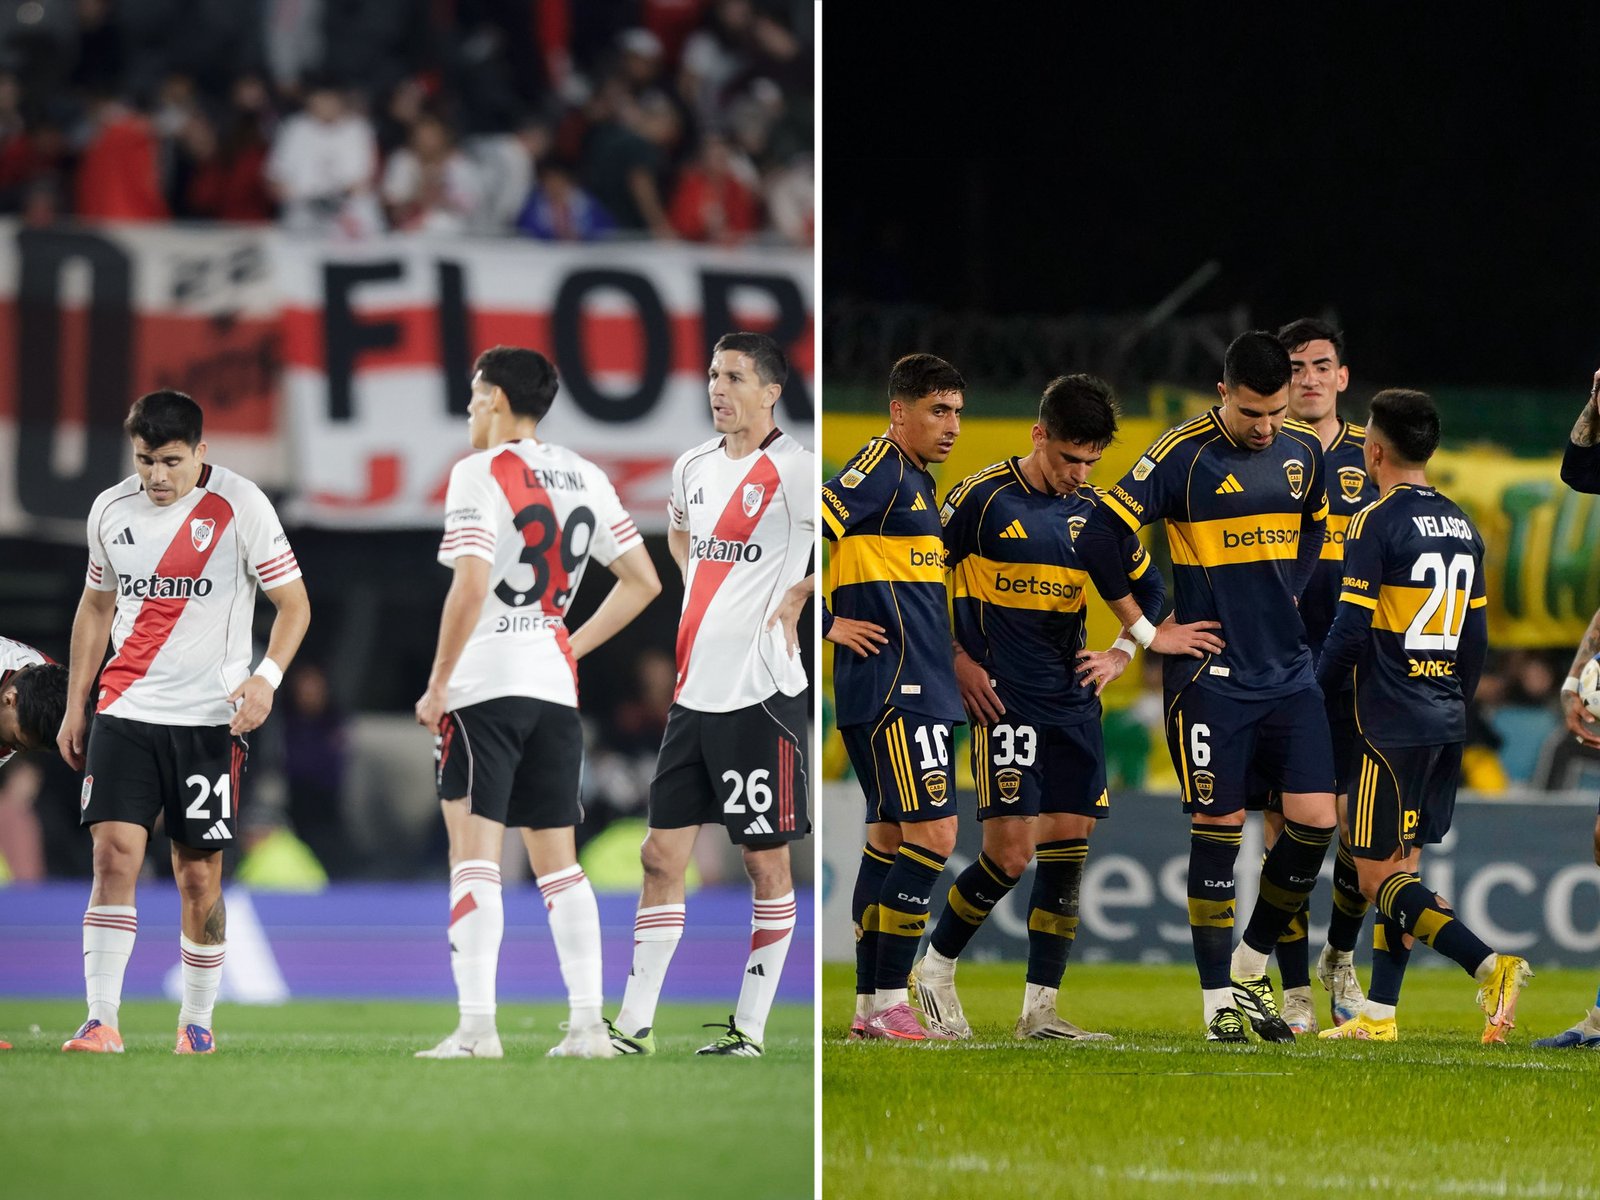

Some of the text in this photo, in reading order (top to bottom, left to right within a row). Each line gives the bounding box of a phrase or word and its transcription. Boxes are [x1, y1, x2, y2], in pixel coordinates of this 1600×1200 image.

[523, 468, 588, 492] LENCINA
[821, 486, 850, 521] TROGAR
[1411, 515, 1473, 541] VELASCO
[494, 503, 597, 608] 39
[118, 573, 213, 597] Betano
[1404, 552, 1476, 651] 20
[1407, 658, 1456, 677] DIREC
[992, 724, 1037, 767] 33
[1191, 723, 1211, 767] 6
[185, 773, 231, 819] 21
[722, 769, 774, 814] 26
